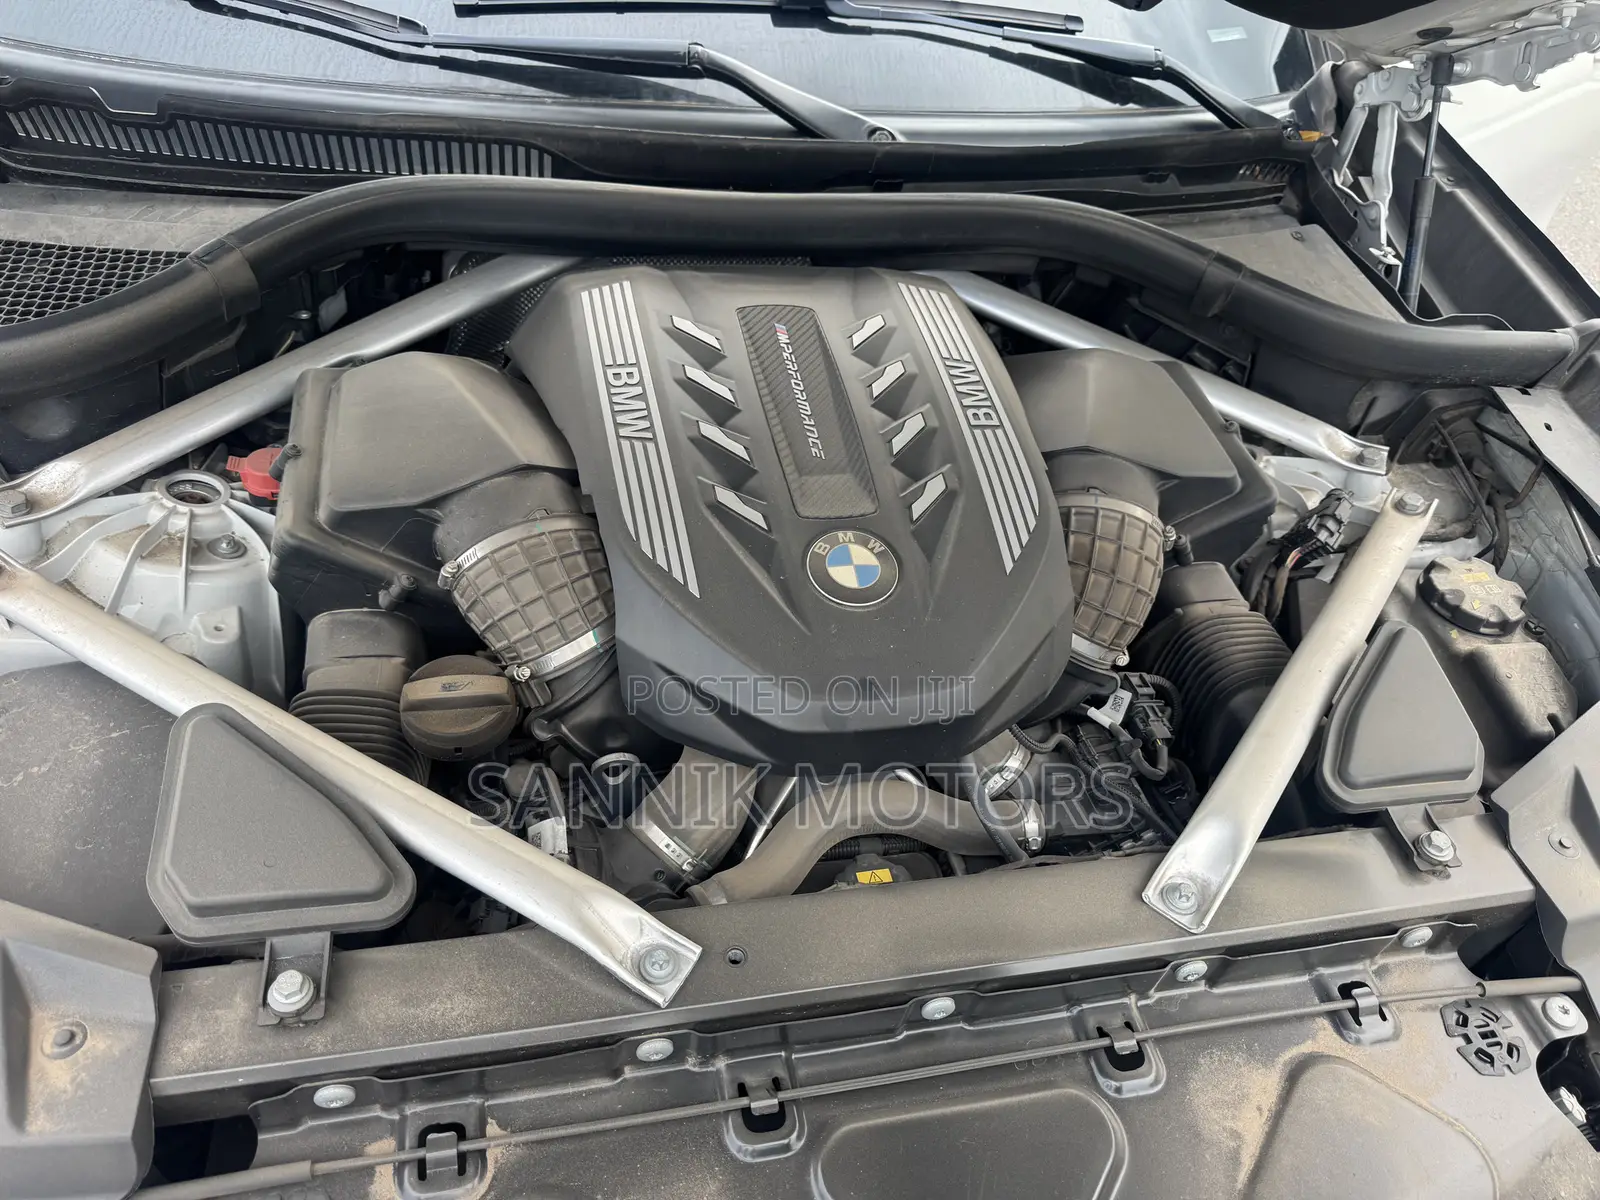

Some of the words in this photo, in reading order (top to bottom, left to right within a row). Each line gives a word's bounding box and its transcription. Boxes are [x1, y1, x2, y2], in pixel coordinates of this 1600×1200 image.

[606, 367, 654, 439] BMW
[944, 361, 1000, 426] BMW
[813, 532, 885, 556] BMW
